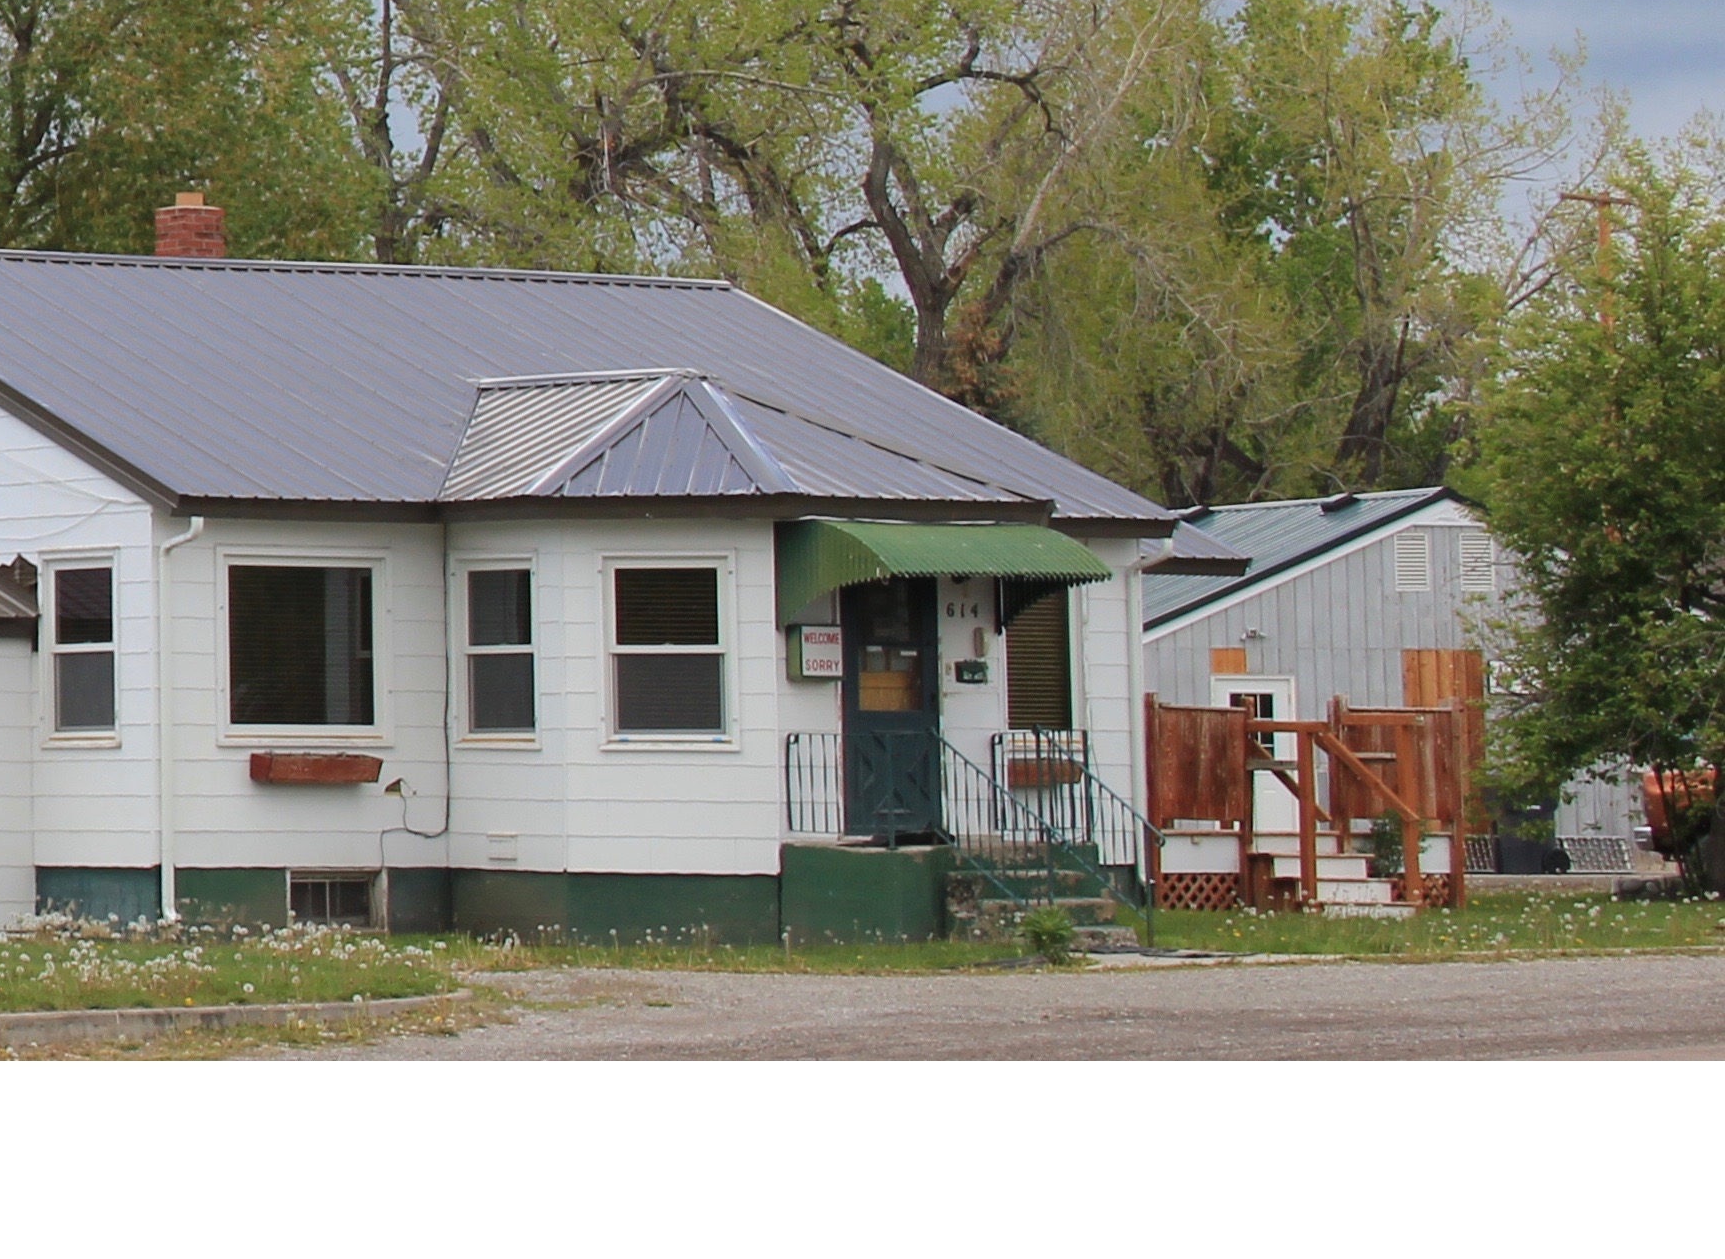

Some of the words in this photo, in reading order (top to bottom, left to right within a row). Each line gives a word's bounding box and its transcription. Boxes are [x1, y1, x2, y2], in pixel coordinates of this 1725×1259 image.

[946, 602, 979, 618] 614
[804, 632, 840, 645] WELCOME
[805, 658, 840, 671] SORRY
